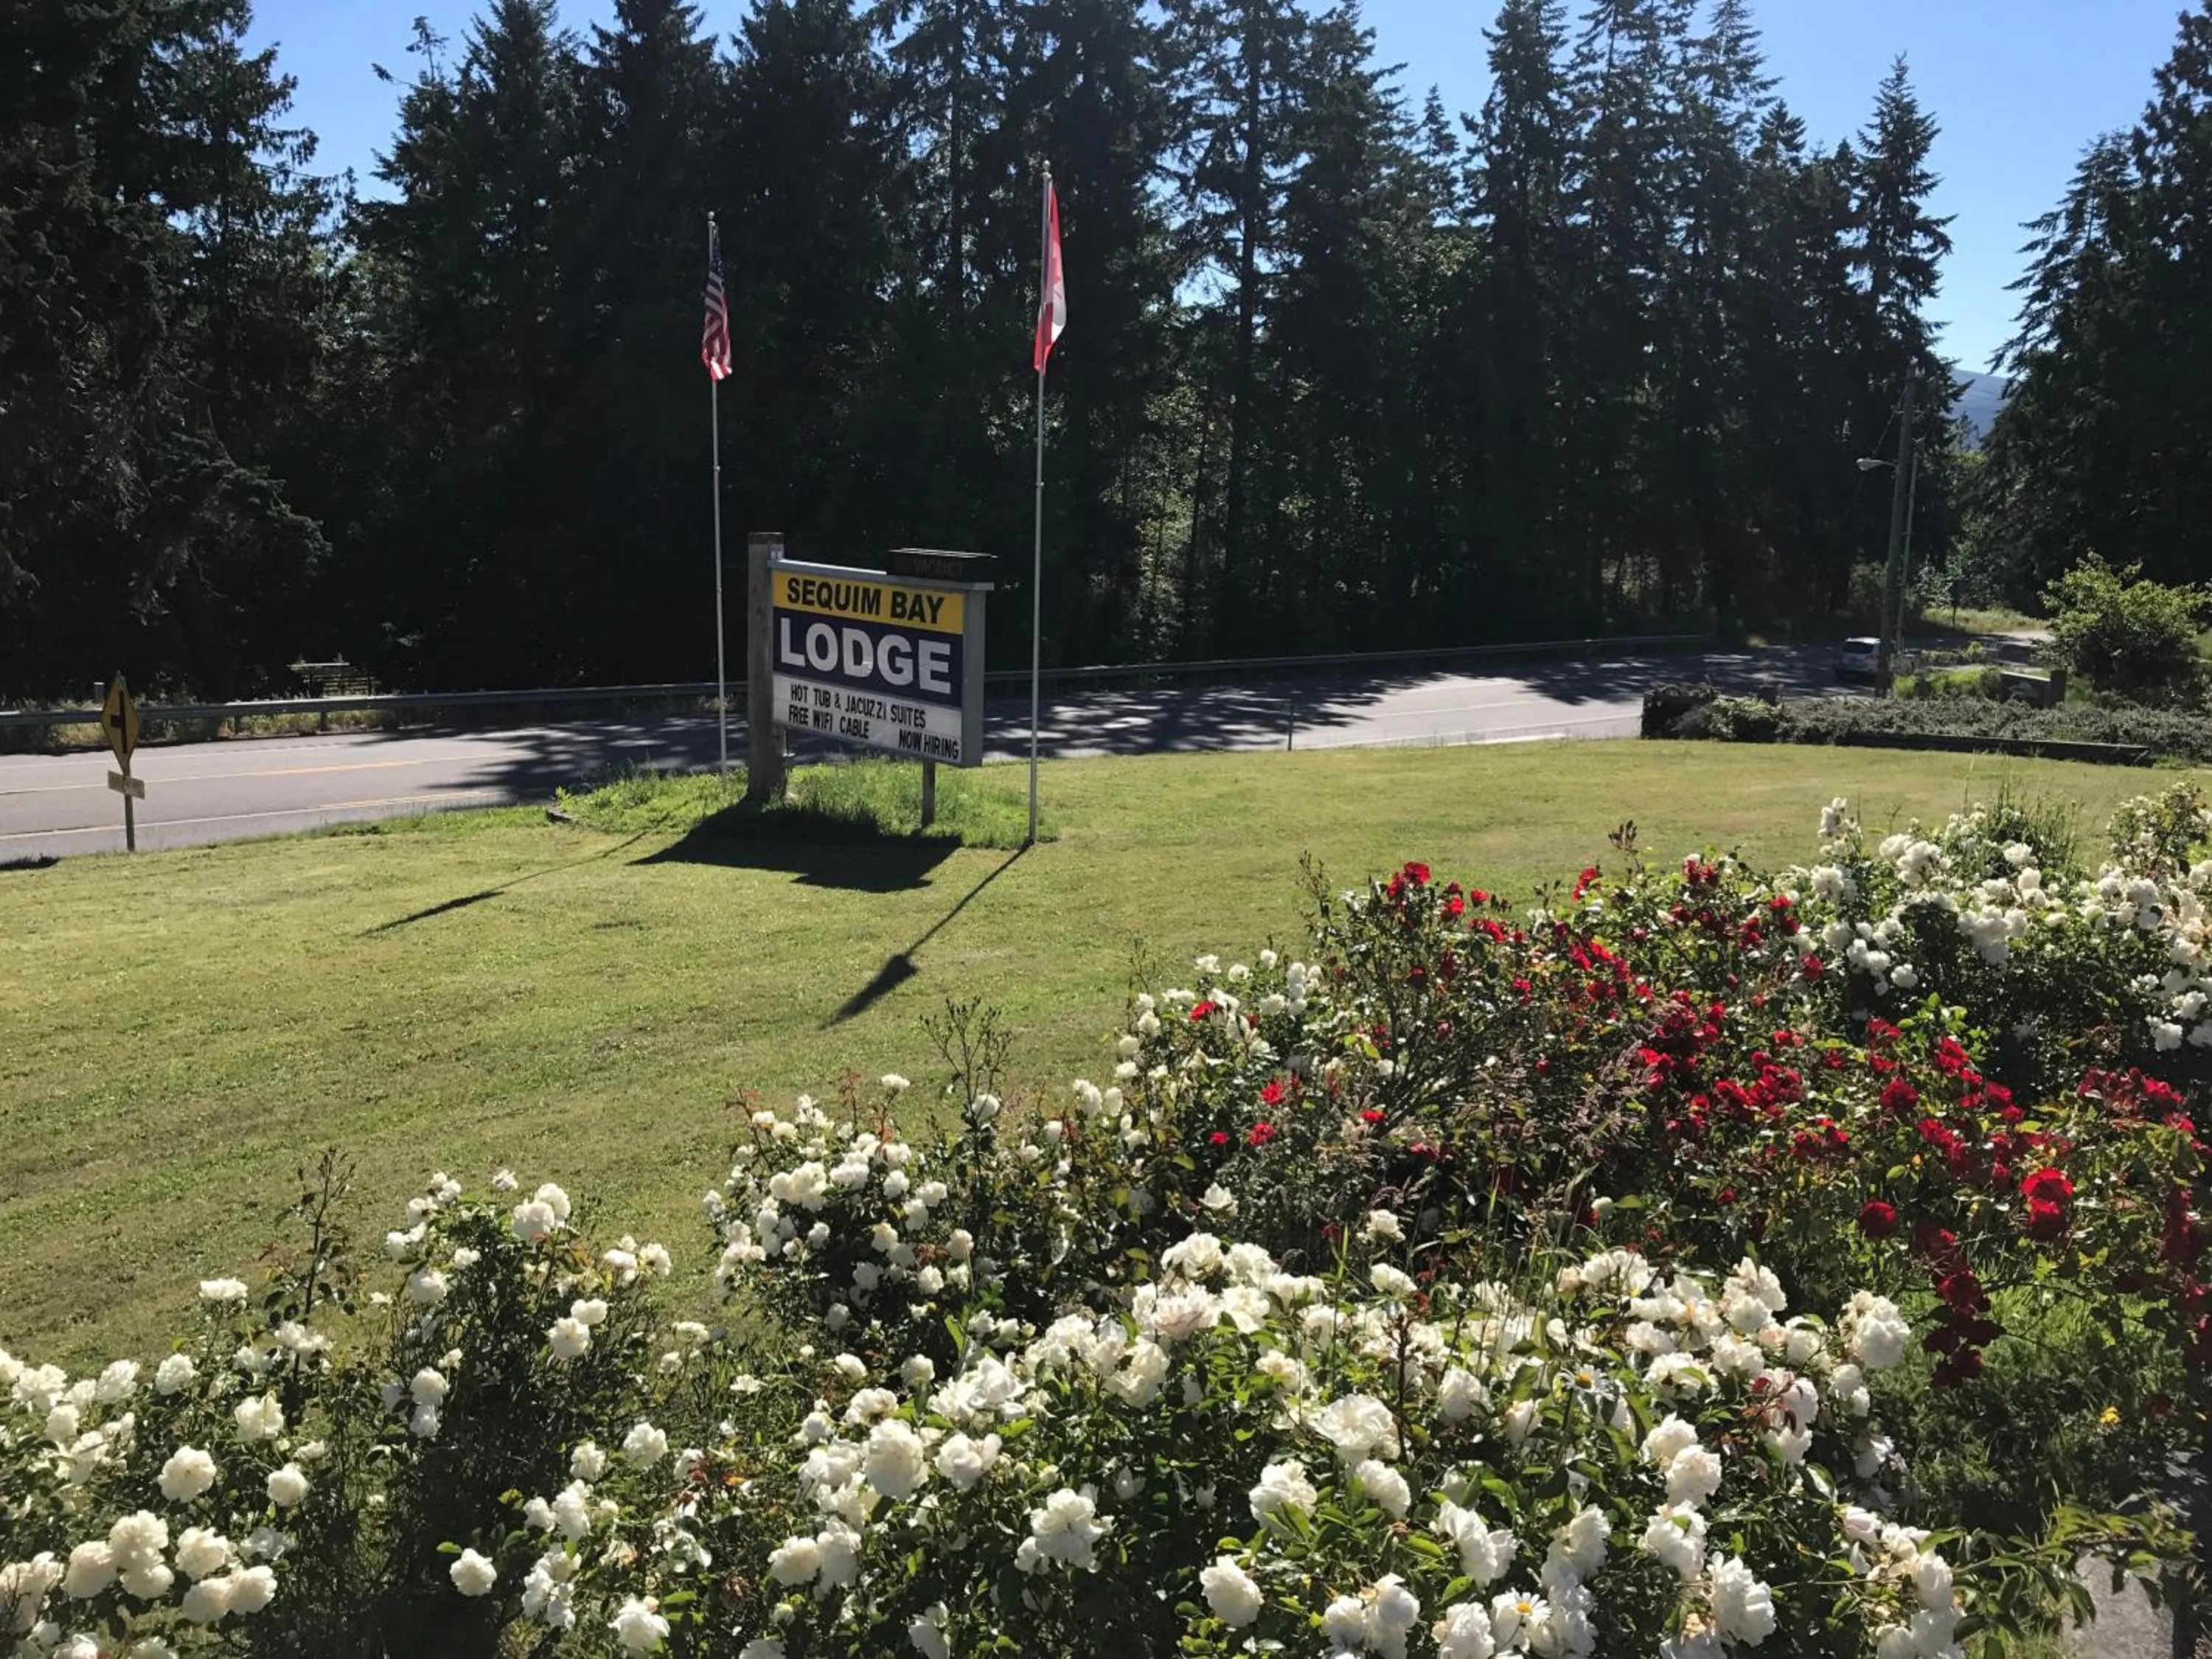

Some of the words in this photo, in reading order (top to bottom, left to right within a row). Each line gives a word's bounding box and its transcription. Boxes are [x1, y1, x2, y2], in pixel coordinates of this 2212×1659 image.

[787, 577, 881, 616] SEQUIM
[890, 591, 945, 625] BAY
[781, 617, 951, 694] LODGE
[788, 704, 809, 726] FREE
[813, 710, 832, 731] WIFI
[840, 716, 870, 739] CABLE
[899, 728, 922, 752] NOW
[924, 734, 959, 760] HIRING
[790, 684, 808, 703] HOT
[813, 688, 831, 708] TUB
[834, 693, 841, 709] &
[891, 704, 926, 728] SUITES
